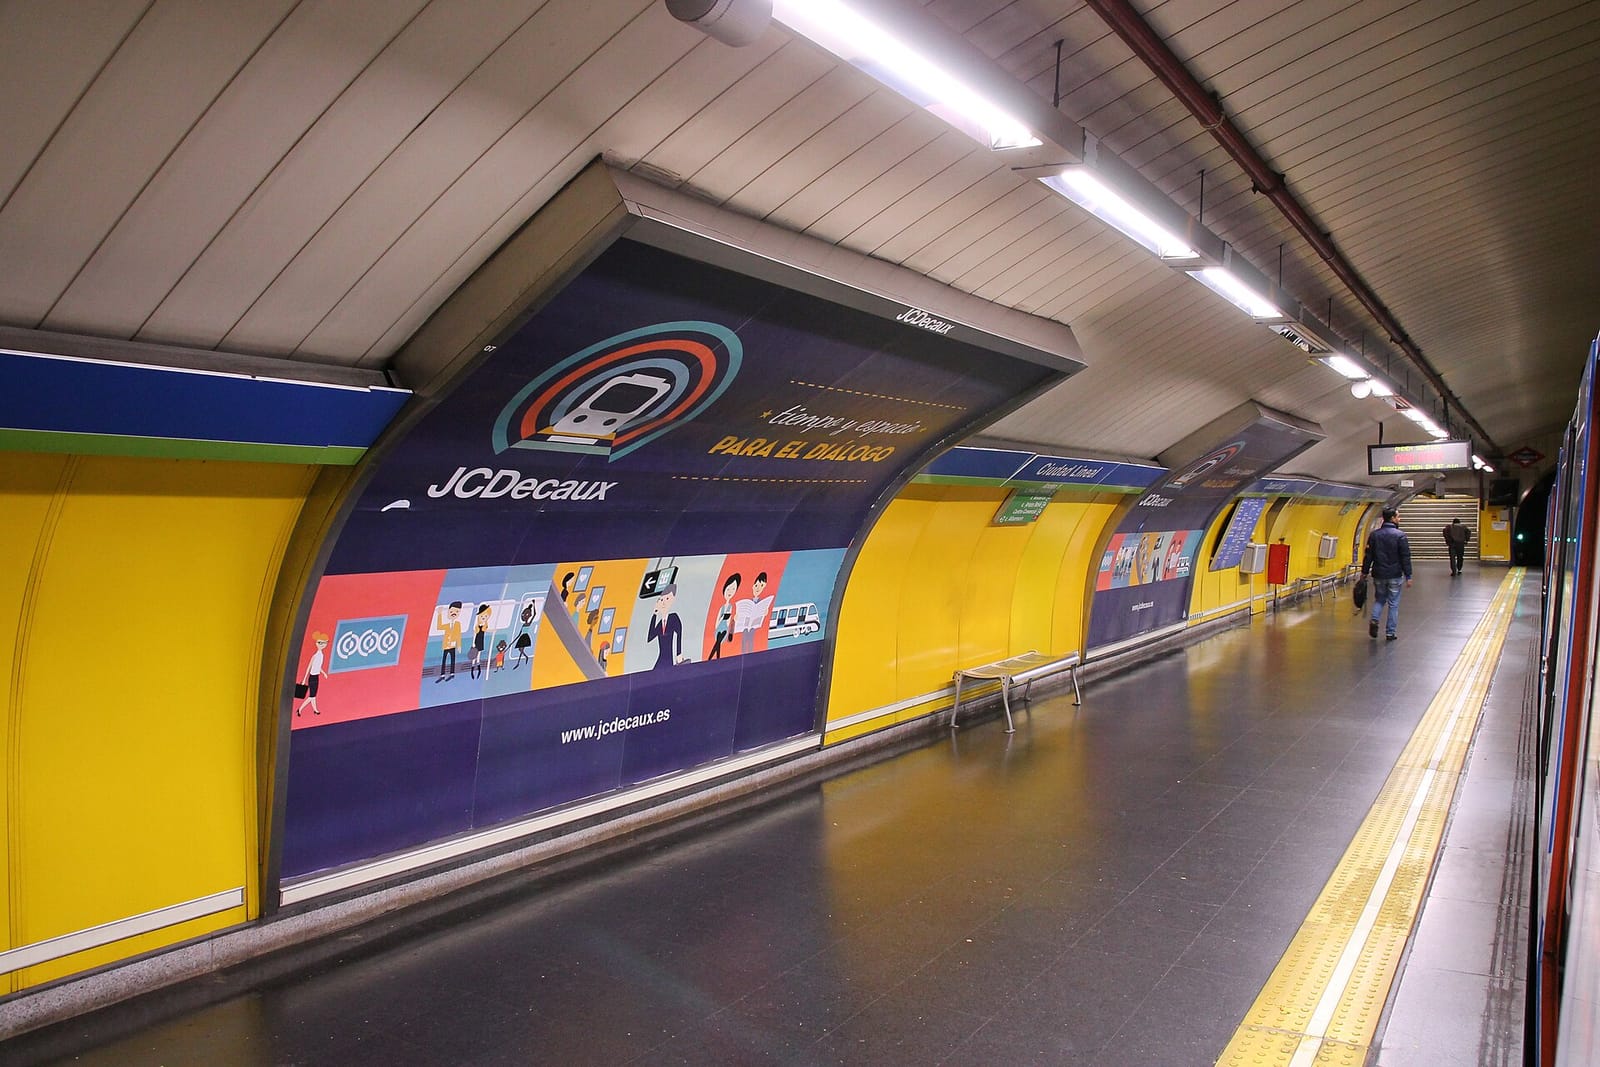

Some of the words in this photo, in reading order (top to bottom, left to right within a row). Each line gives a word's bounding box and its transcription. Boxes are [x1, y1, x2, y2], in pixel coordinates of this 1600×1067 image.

[896, 308, 955, 334] JCDecaux
[768, 404, 845, 433] tiempo
[854, 419, 921, 438] espacio
[708, 435, 778, 458] PARA
[773, 440, 809, 459] EL
[802, 440, 896, 462] DIÁLOGO
[427, 466, 618, 500] JCDecaux
[1036, 462, 1078, 477] Ciudad
[1069, 465, 1104, 478] Lineal
[561, 708, 671, 744] www.jcdecaux.es
